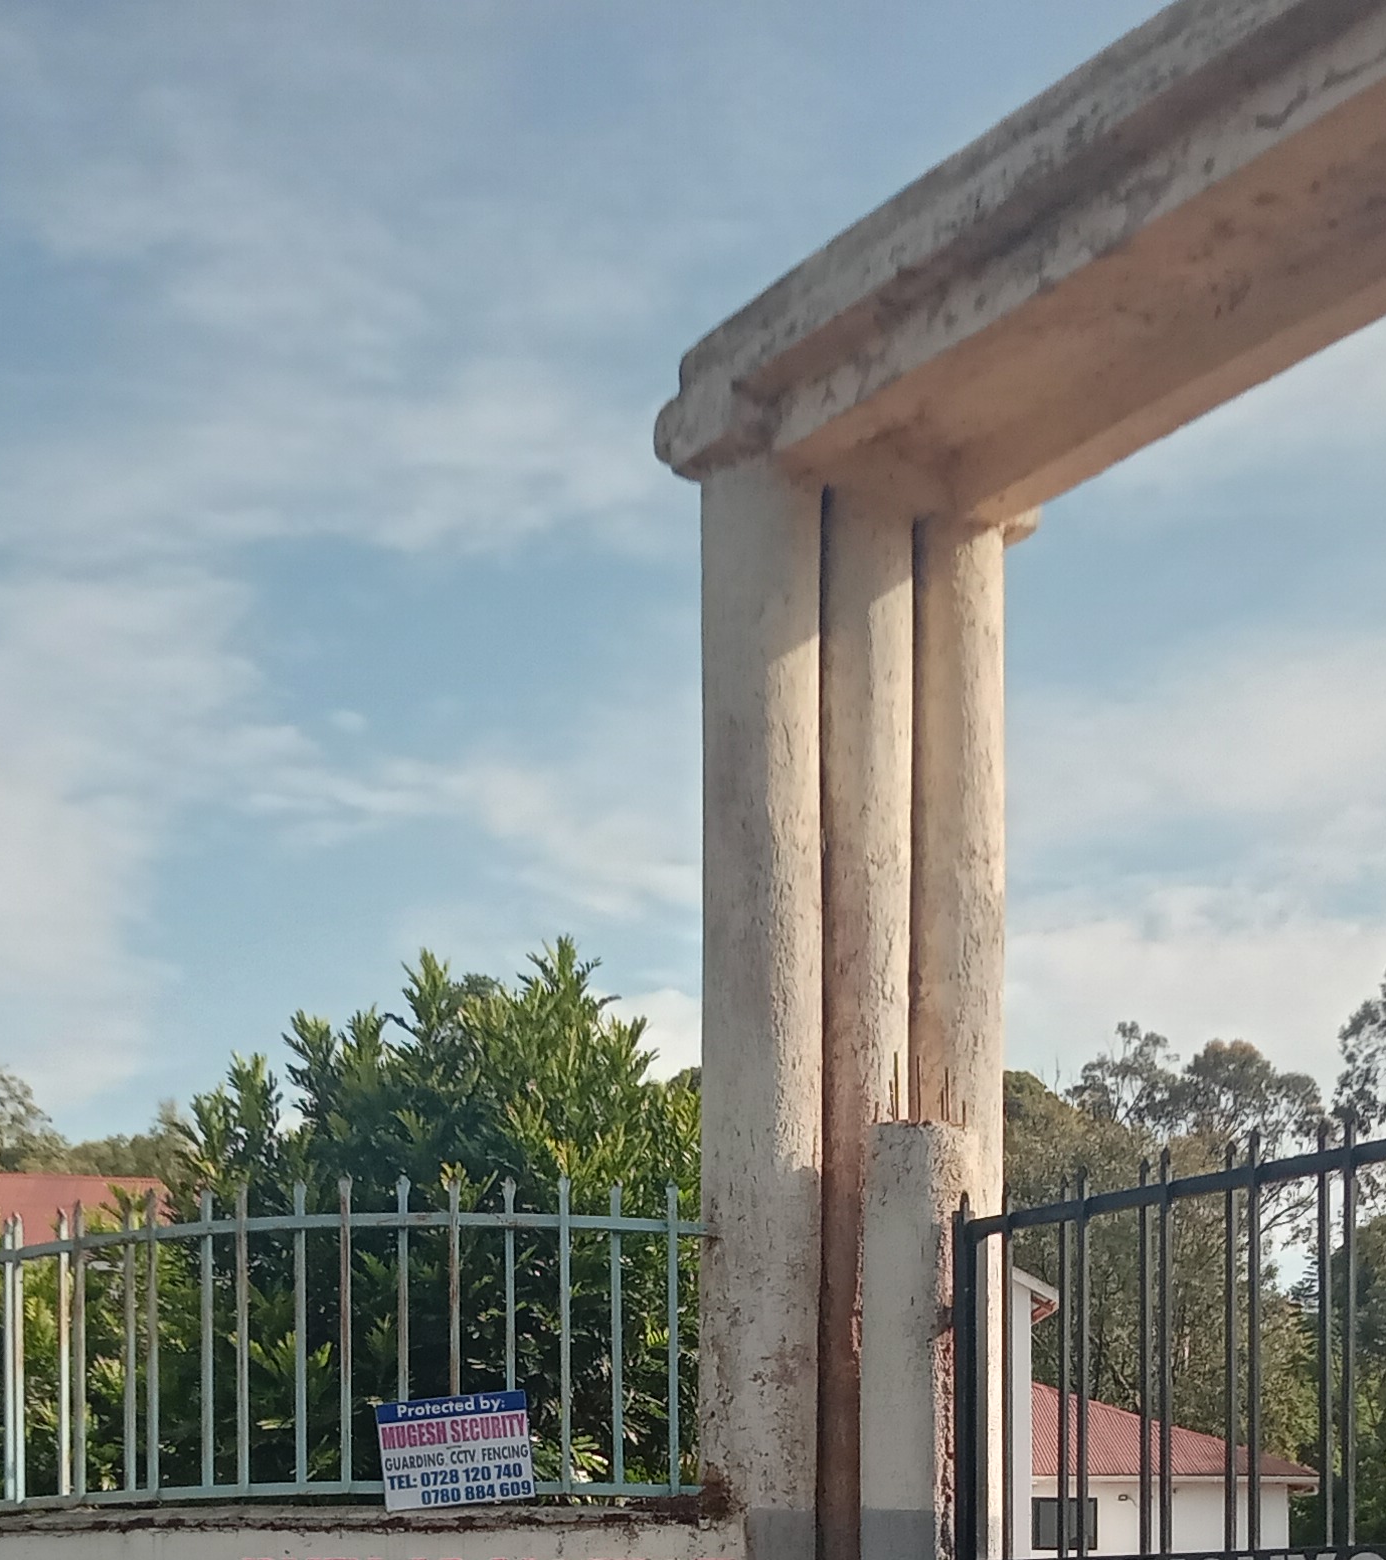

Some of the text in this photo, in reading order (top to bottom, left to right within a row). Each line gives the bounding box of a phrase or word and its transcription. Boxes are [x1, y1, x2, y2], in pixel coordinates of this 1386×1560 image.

[397, 1395, 506, 1418] Protected by:
[381, 1413, 525, 1451] MUGESH SECURITY
[482, 1444, 529, 1463] FENCING
[387, 1462, 523, 1491] TEL: 0728 120 740
[421, 1480, 532, 1506] 0780 884 609
